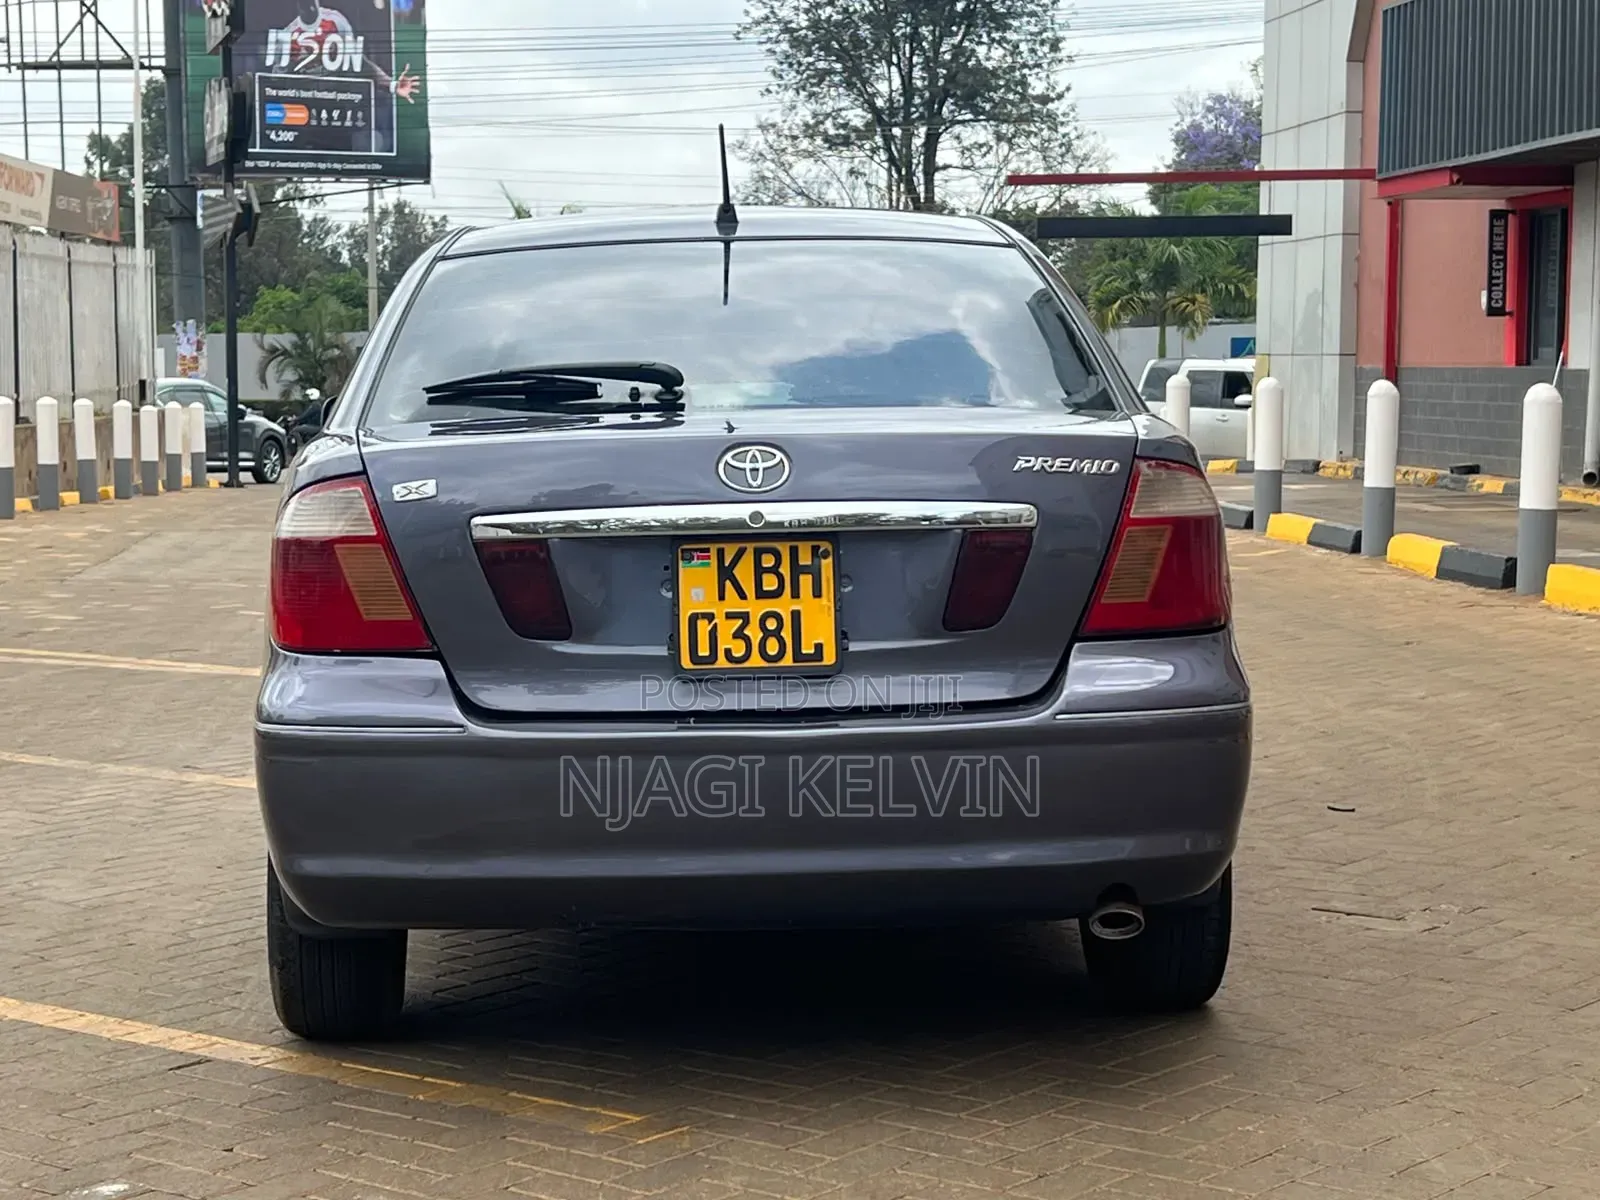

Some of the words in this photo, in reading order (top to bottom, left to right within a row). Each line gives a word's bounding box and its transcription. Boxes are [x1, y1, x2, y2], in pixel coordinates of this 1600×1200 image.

[321, 33, 364, 72] ON
[265, 87, 276, 96] The
[278, 88, 299, 97] world's
[337, 92, 362, 103] package
[1492, 218, 1505, 251] HERE
[1491, 254, 1505, 308] COLLECT
[1012, 456, 1121, 475] PREMIO
[716, 545, 823, 601] KBH
[688, 609, 824, 666] 038L
